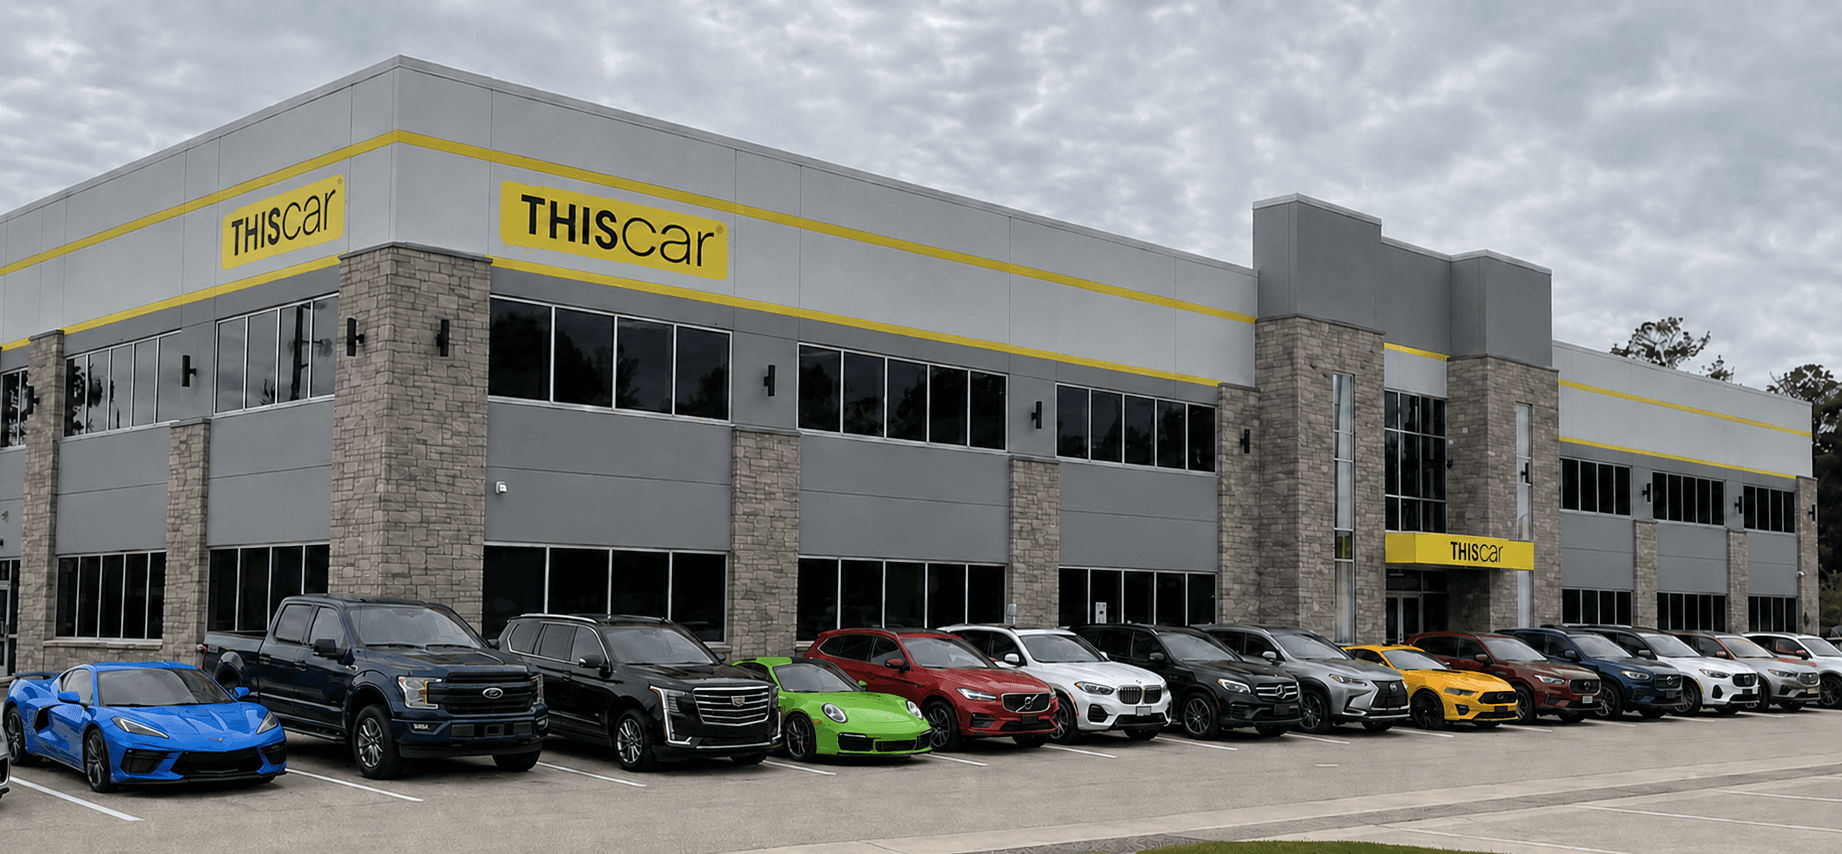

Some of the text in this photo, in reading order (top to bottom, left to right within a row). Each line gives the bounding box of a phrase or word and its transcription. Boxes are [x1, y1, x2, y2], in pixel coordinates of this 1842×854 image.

[231, 188, 337, 256] THIScar
[521, 193, 715, 267] THIScar
[1450, 541, 1504, 563] THIScar
